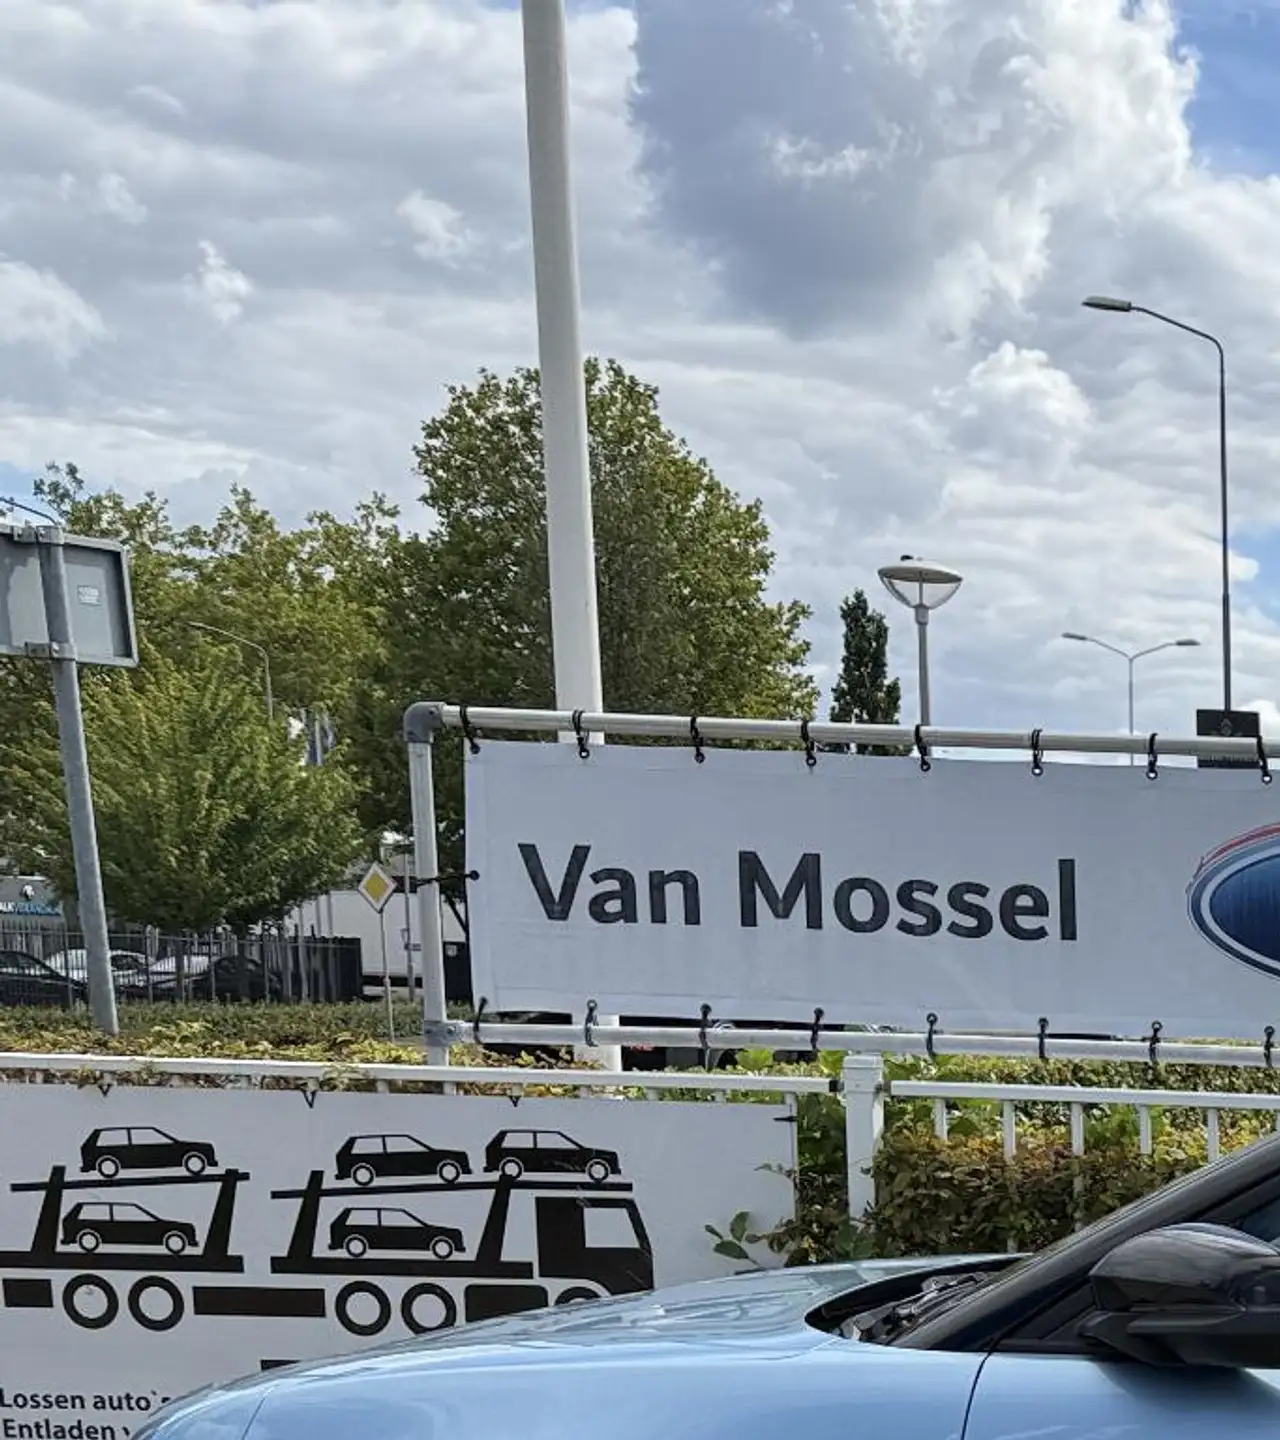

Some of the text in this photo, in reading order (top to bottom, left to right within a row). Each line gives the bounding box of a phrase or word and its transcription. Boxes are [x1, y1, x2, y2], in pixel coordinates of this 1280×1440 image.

[517, 842, 1078, 942] Van Mossel
[0, 1388, 86, 1409] Lossen
[2, 1418, 116, 1440] Entladen
